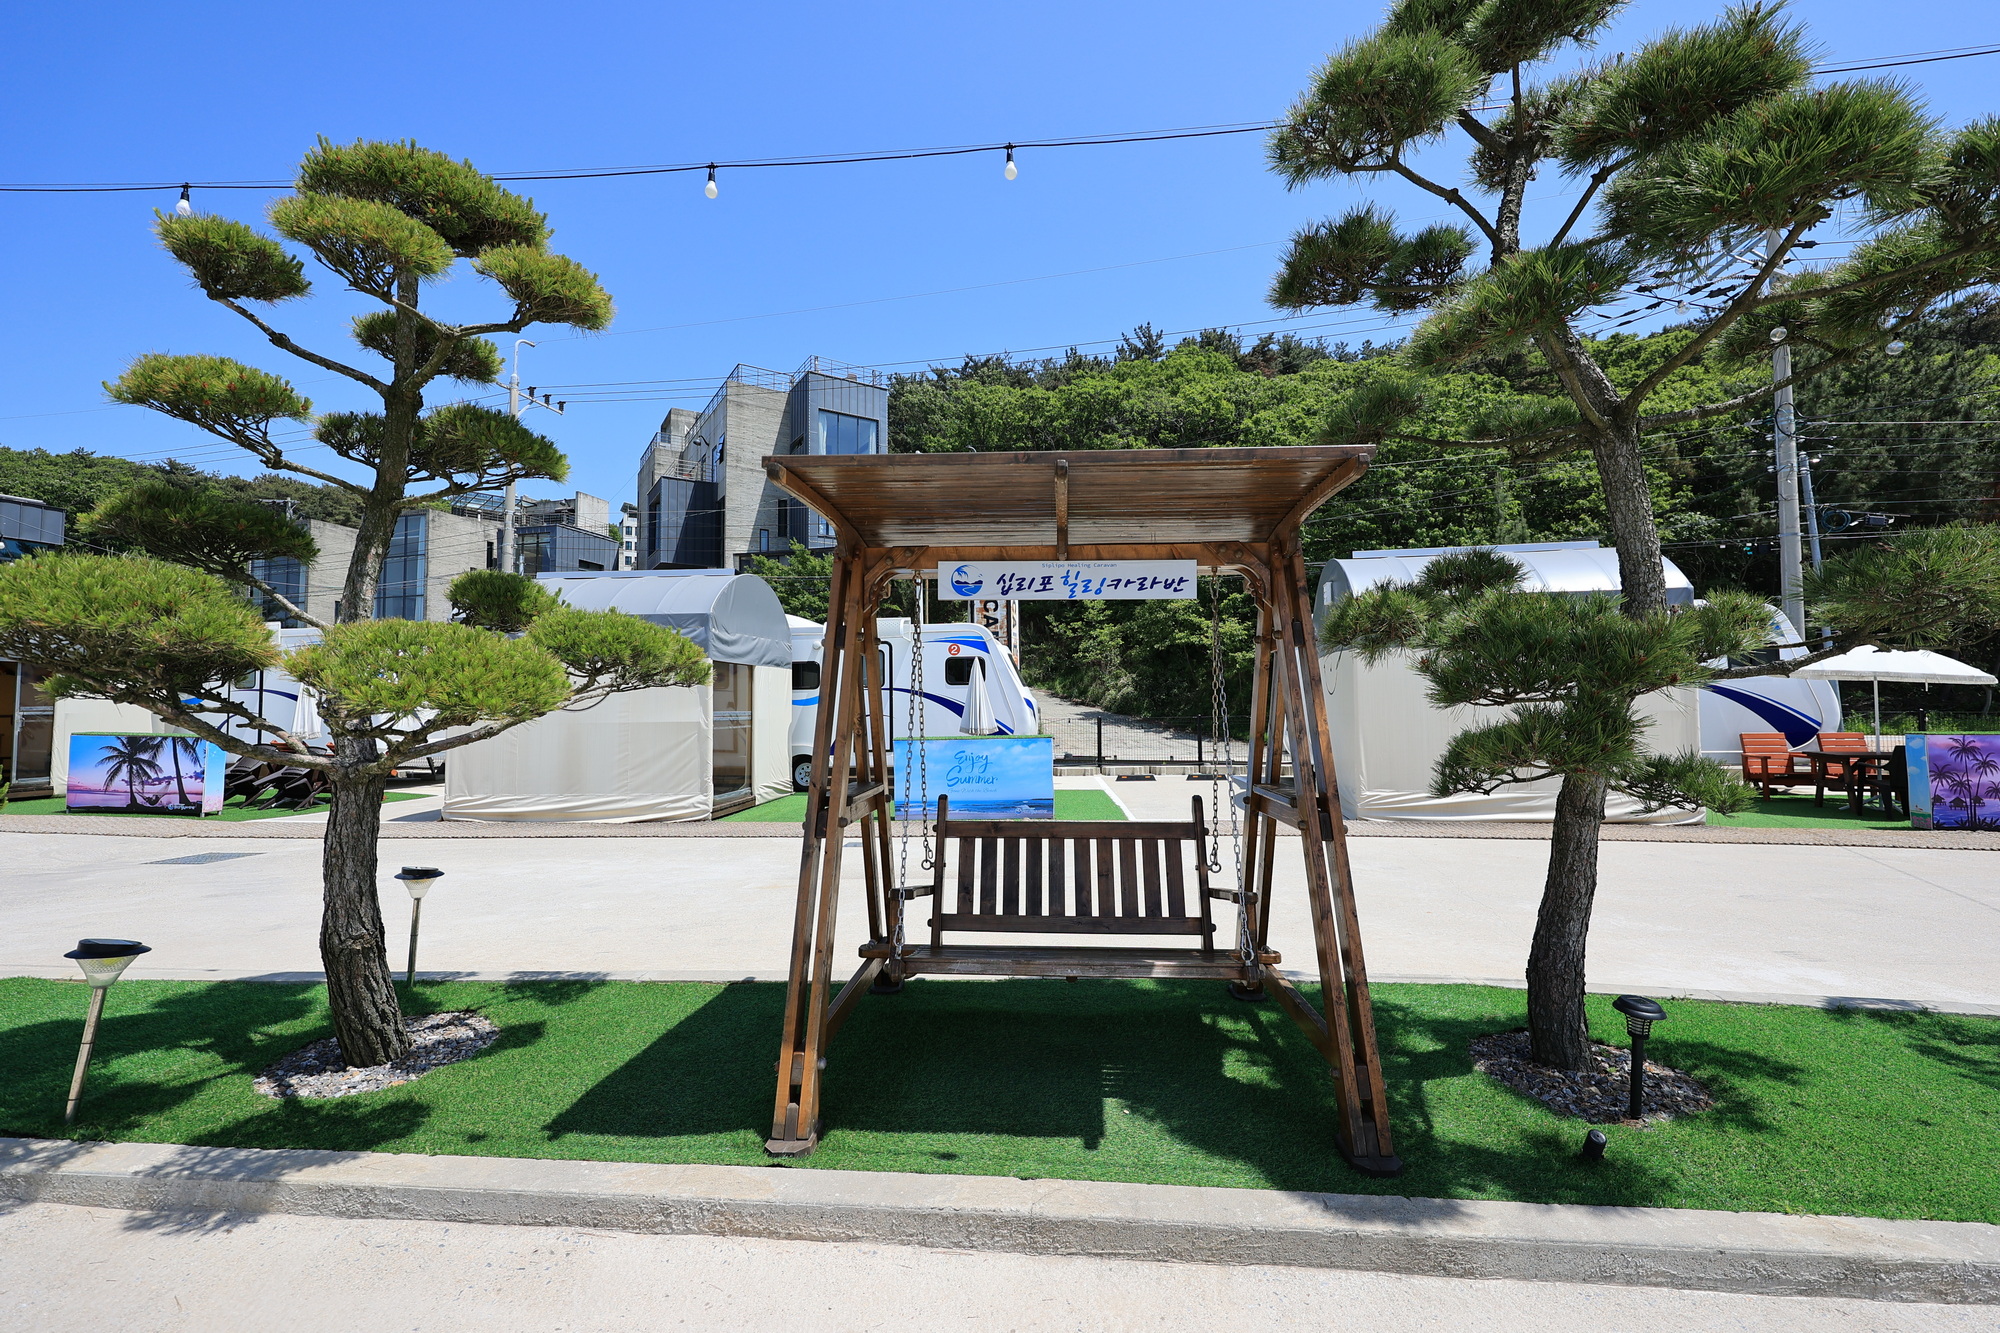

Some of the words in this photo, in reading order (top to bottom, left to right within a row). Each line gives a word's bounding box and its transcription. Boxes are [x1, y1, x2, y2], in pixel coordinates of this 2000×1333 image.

[996, 573, 1054, 596] 십리포
[951, 645, 958, 654] 2
[954, 750, 993, 774] Enjoy
[946, 765, 998, 787] Summer
